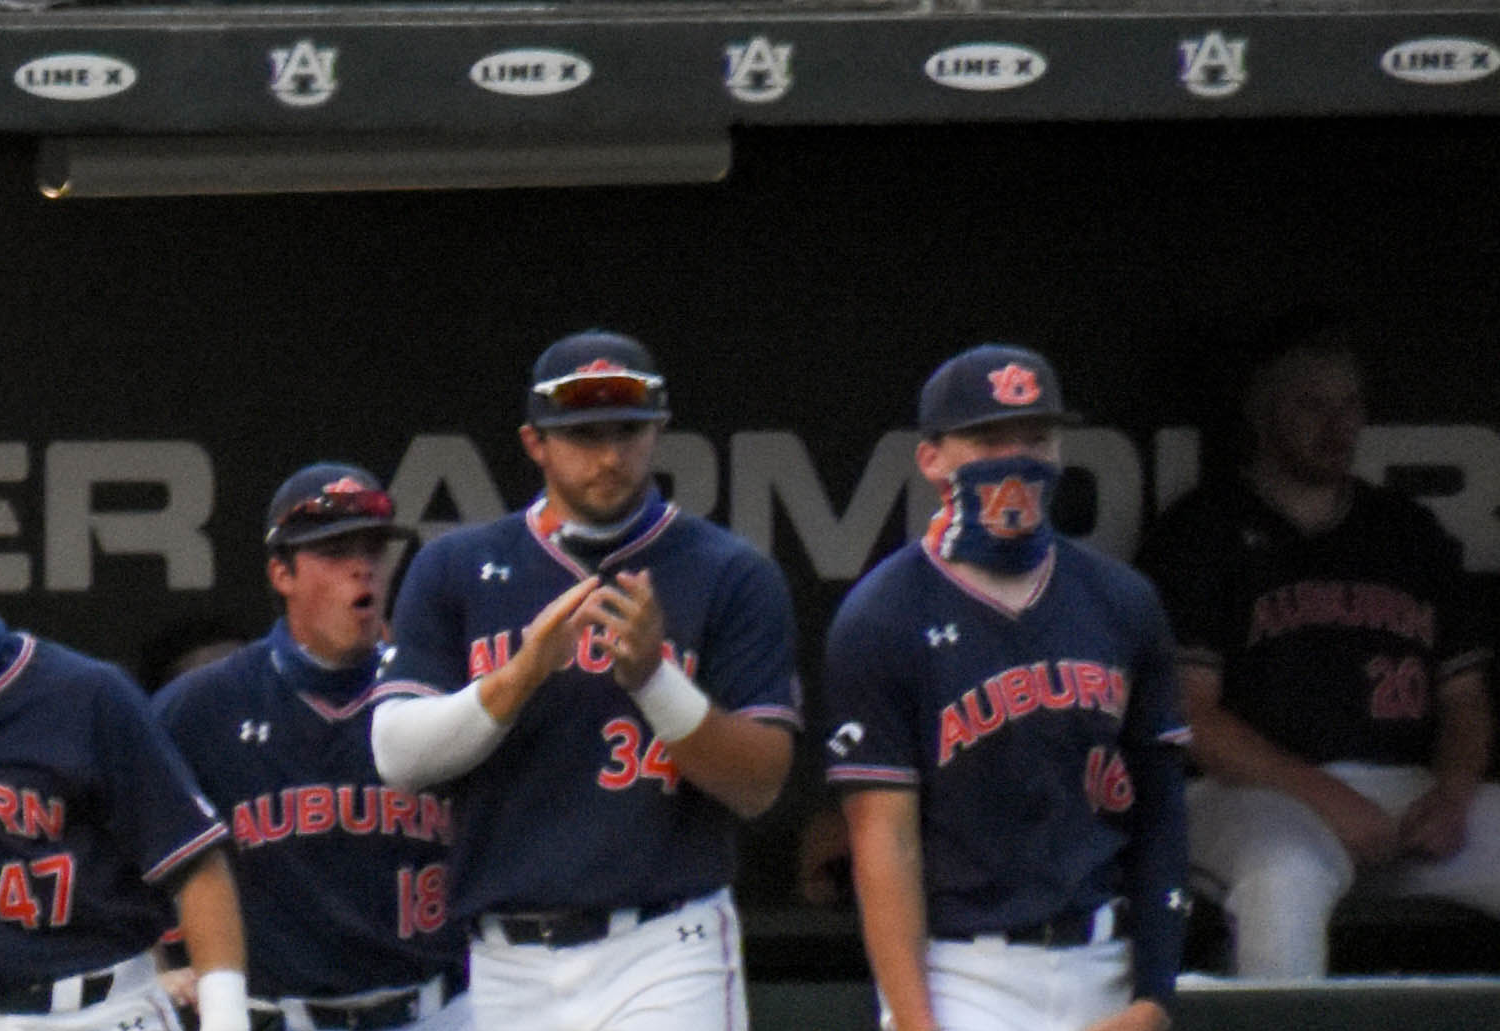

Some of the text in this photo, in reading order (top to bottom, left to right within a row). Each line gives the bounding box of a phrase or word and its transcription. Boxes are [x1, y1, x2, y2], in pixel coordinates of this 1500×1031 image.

[597, 718, 679, 793] 34
[232, 784, 453, 850] AUBURN
[397, 863, 446, 939] 18
